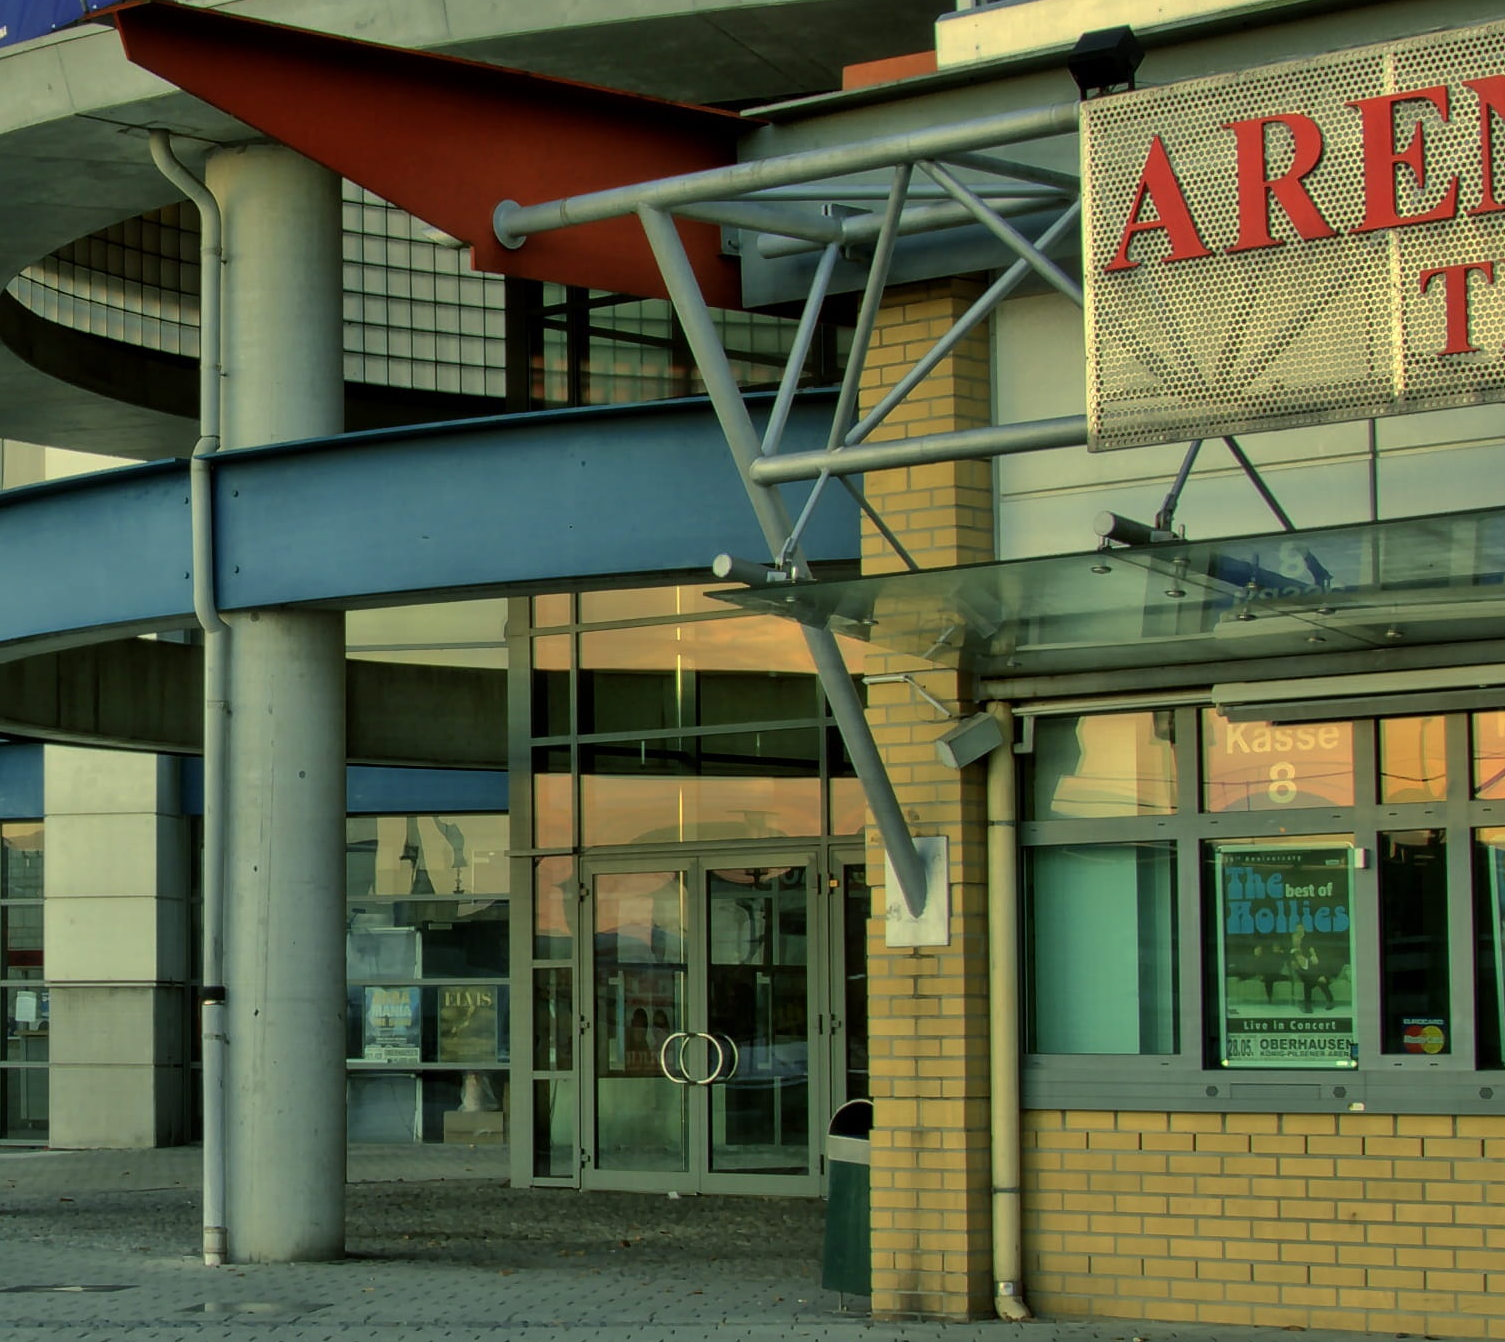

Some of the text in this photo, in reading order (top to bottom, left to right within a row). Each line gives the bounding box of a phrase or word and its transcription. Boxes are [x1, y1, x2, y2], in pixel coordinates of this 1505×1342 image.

[1225, 724, 1340, 755] Kasse
[1268, 762, 1297, 804] 8
[1225, 867, 1333, 899] The best of
[1227, 900, 1349, 934] Hollies
[445, 991, 492, 1006] ELVIS
[1244, 1020, 1336, 1030] Live in Concert
[1260, 1038, 1353, 1050] OBERHAUSEN
